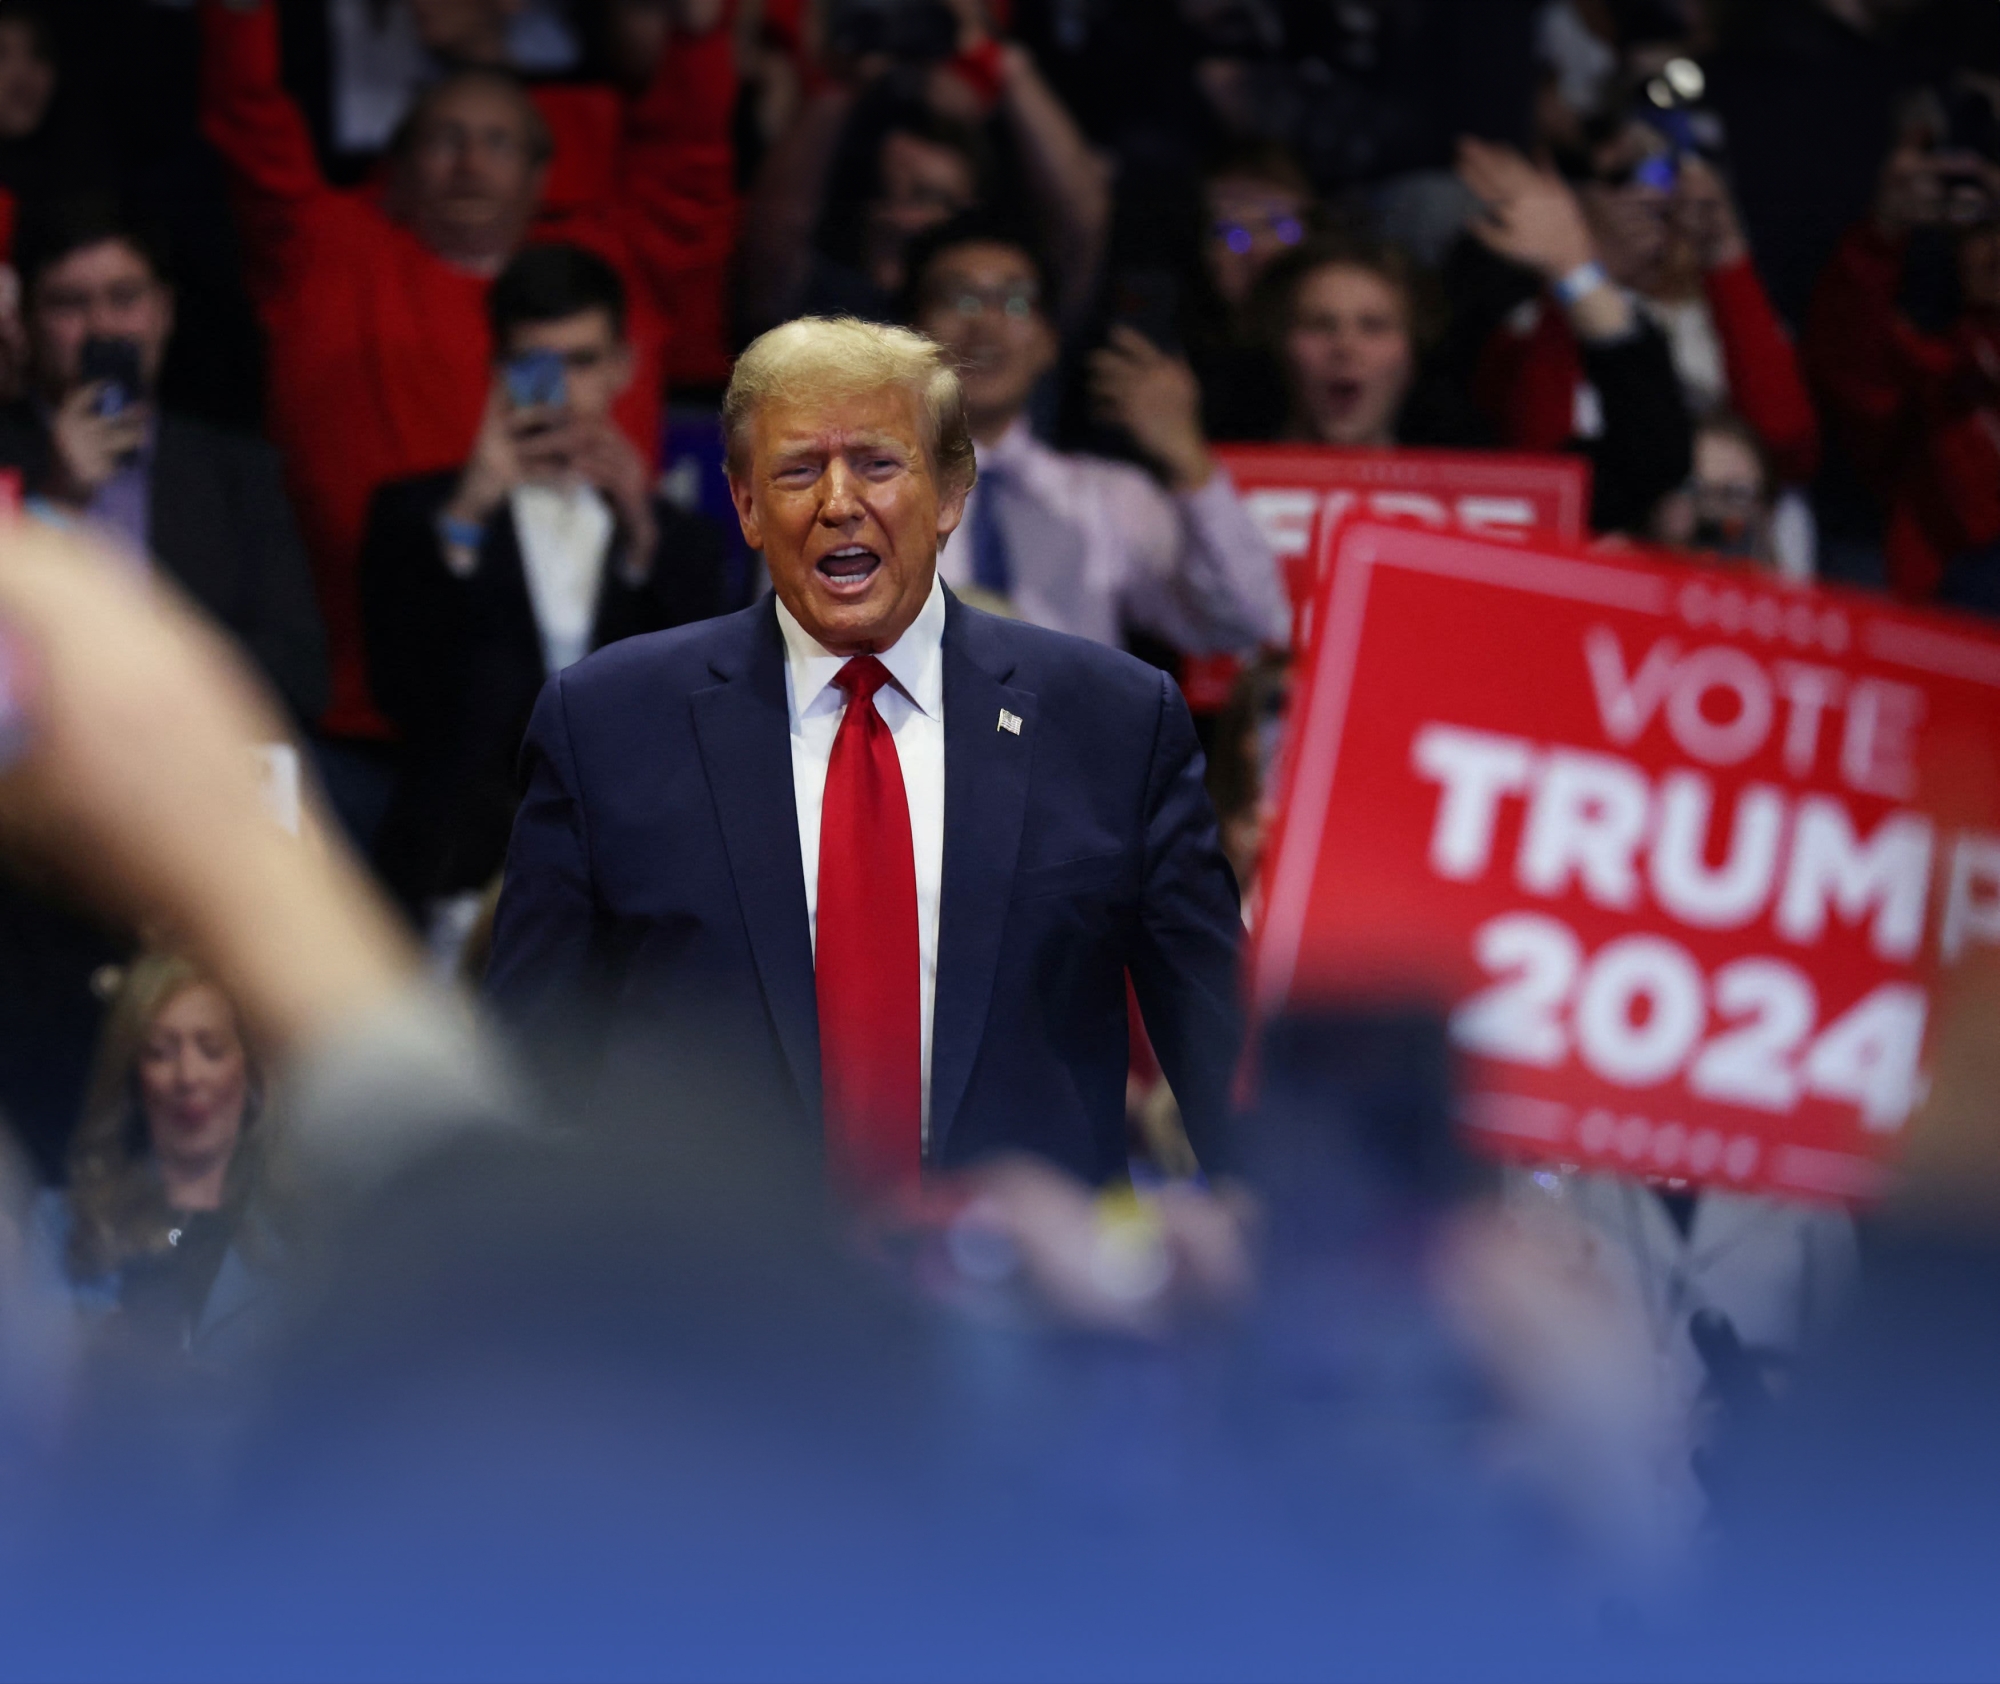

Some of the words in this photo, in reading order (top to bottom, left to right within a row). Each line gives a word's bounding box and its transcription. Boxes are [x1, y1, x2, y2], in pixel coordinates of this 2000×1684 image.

[1583, 628, 1926, 798] VOTE
[1412, 722, 2000, 967] TRUMP
[1448, 911, 1929, 1135] 2024
